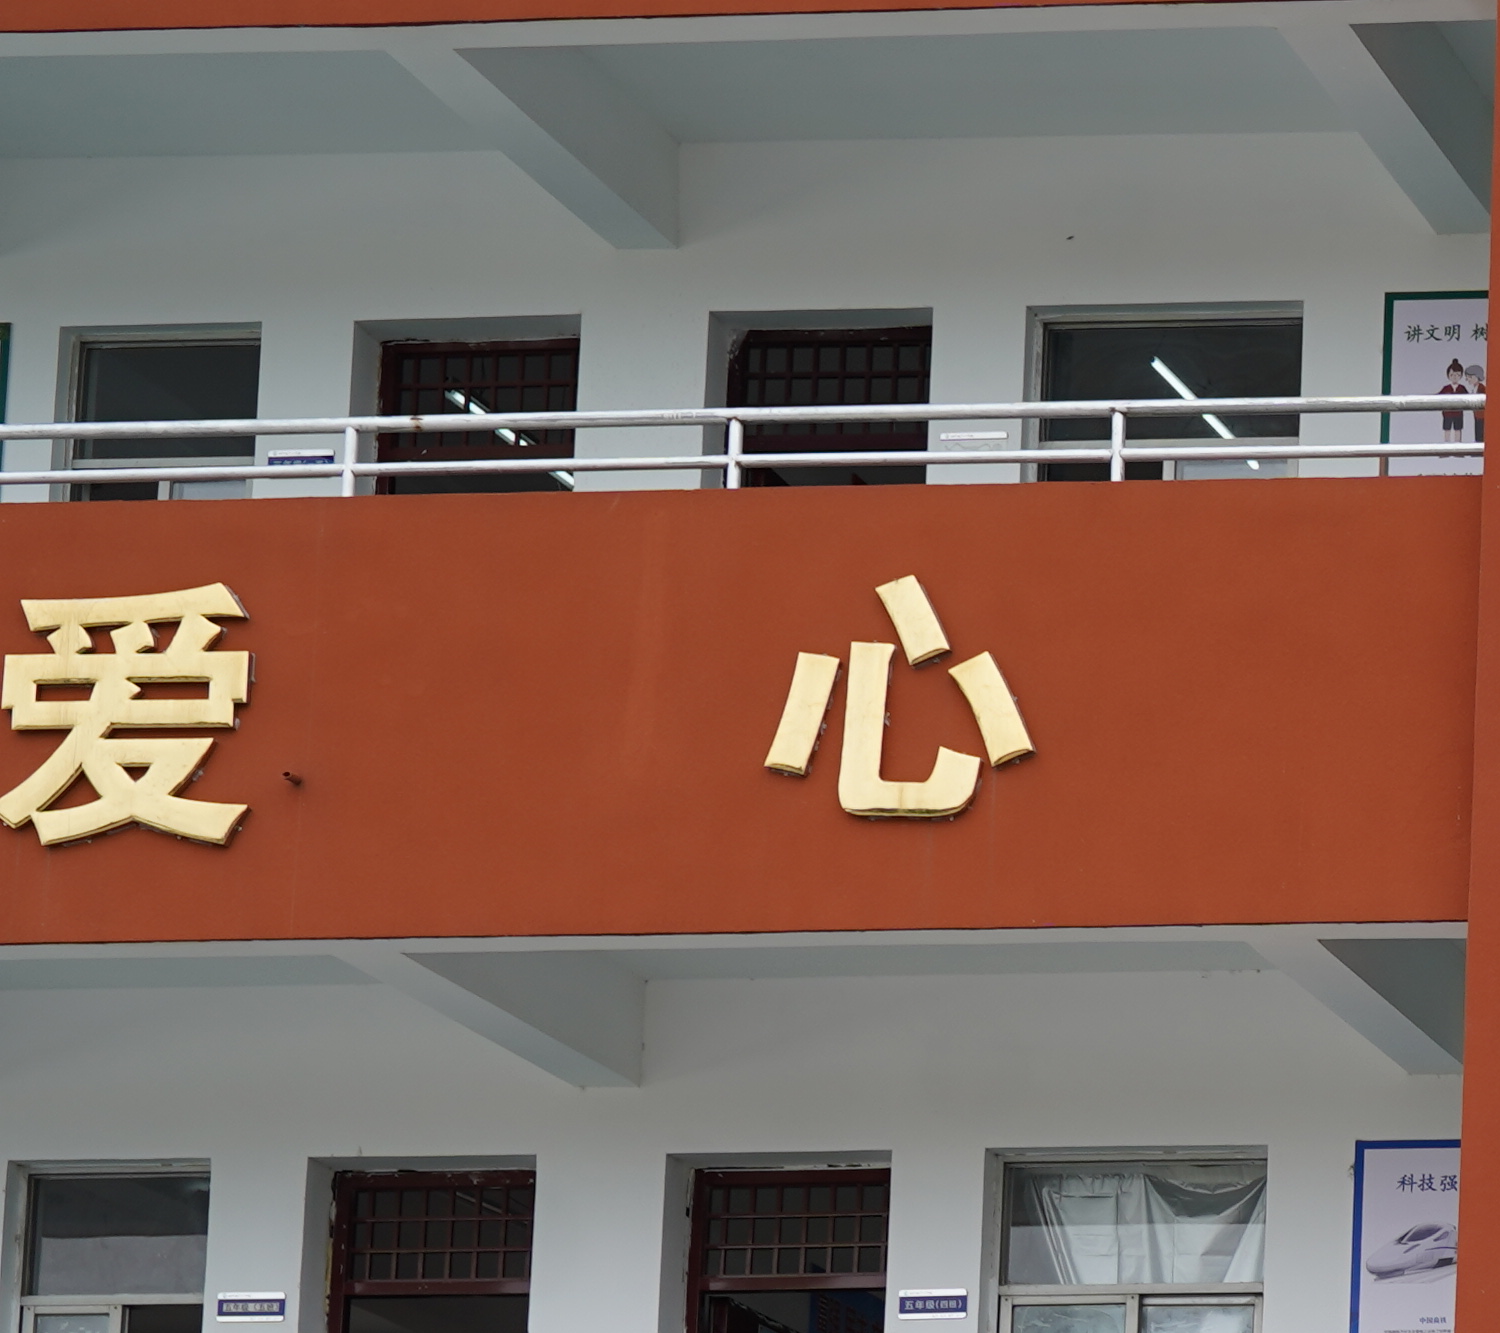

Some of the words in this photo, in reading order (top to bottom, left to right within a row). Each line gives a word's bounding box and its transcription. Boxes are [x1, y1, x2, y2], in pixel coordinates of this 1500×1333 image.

[1404, 324, 1460, 343] 讲文明
[0, 582, 251, 848] 爱
[764, 574, 1037, 819] 心
[1396, 1173, 1459, 1193] 科技强
